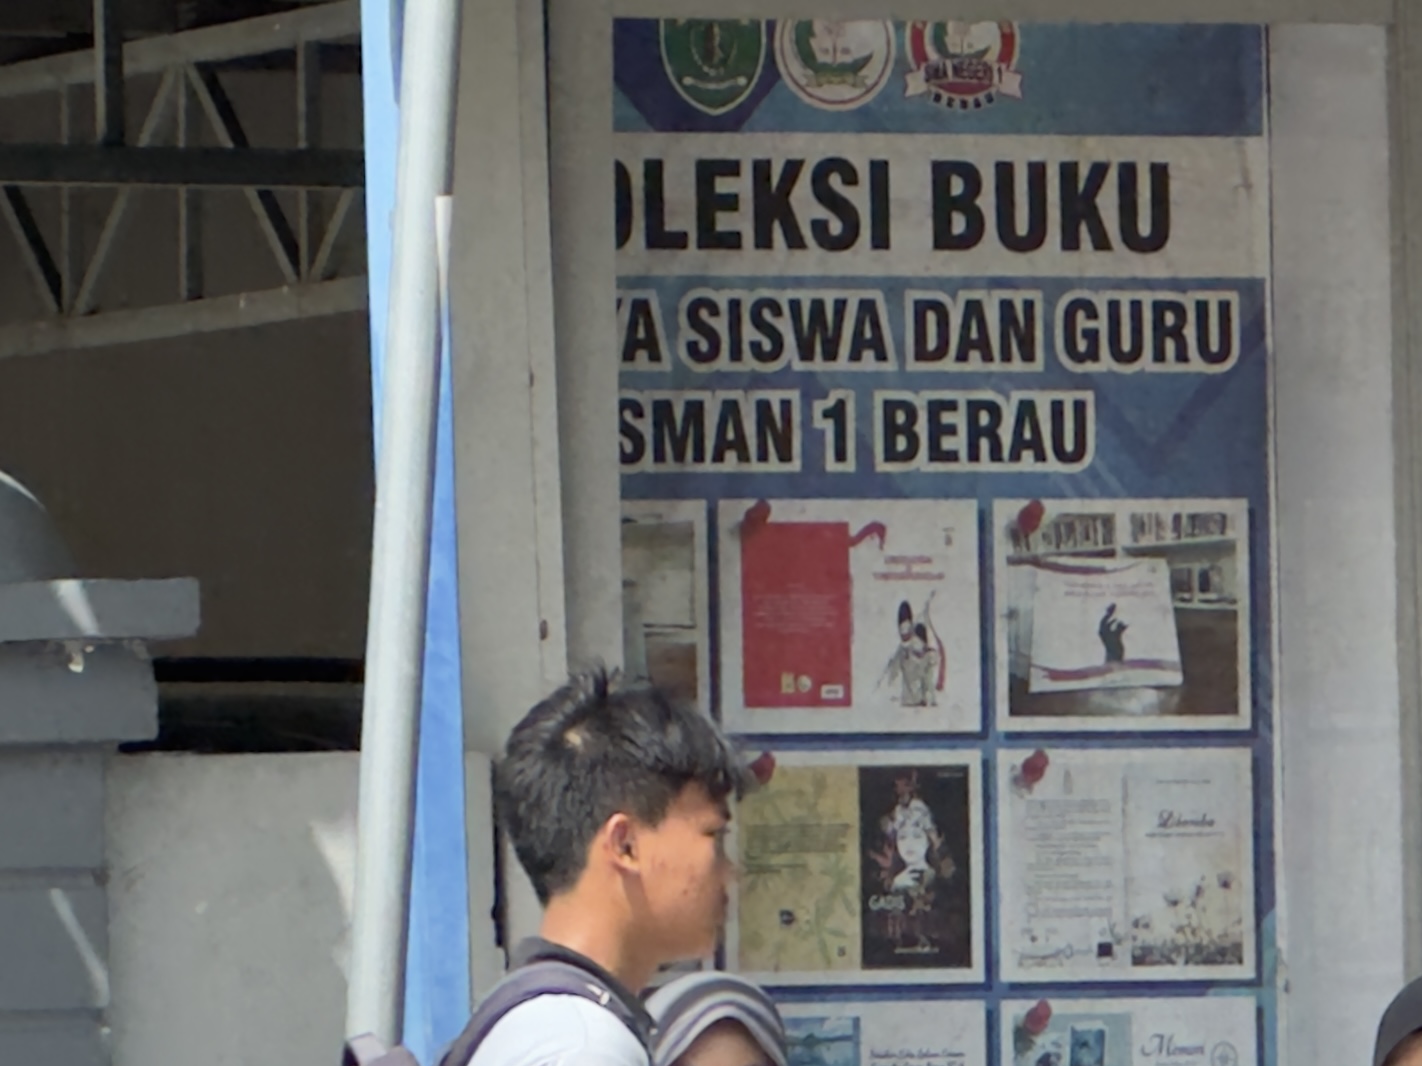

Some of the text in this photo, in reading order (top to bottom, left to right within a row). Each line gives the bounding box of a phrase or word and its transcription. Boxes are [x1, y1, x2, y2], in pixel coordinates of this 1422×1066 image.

[931, 159, 1170, 254] BUKU
[685, 295, 889, 364] SISWA
[912, 297, 1037, 364] DAN
[1063, 296, 1234, 365] GURU
[618, 397, 1089, 466] SMAN 1 BERAU
